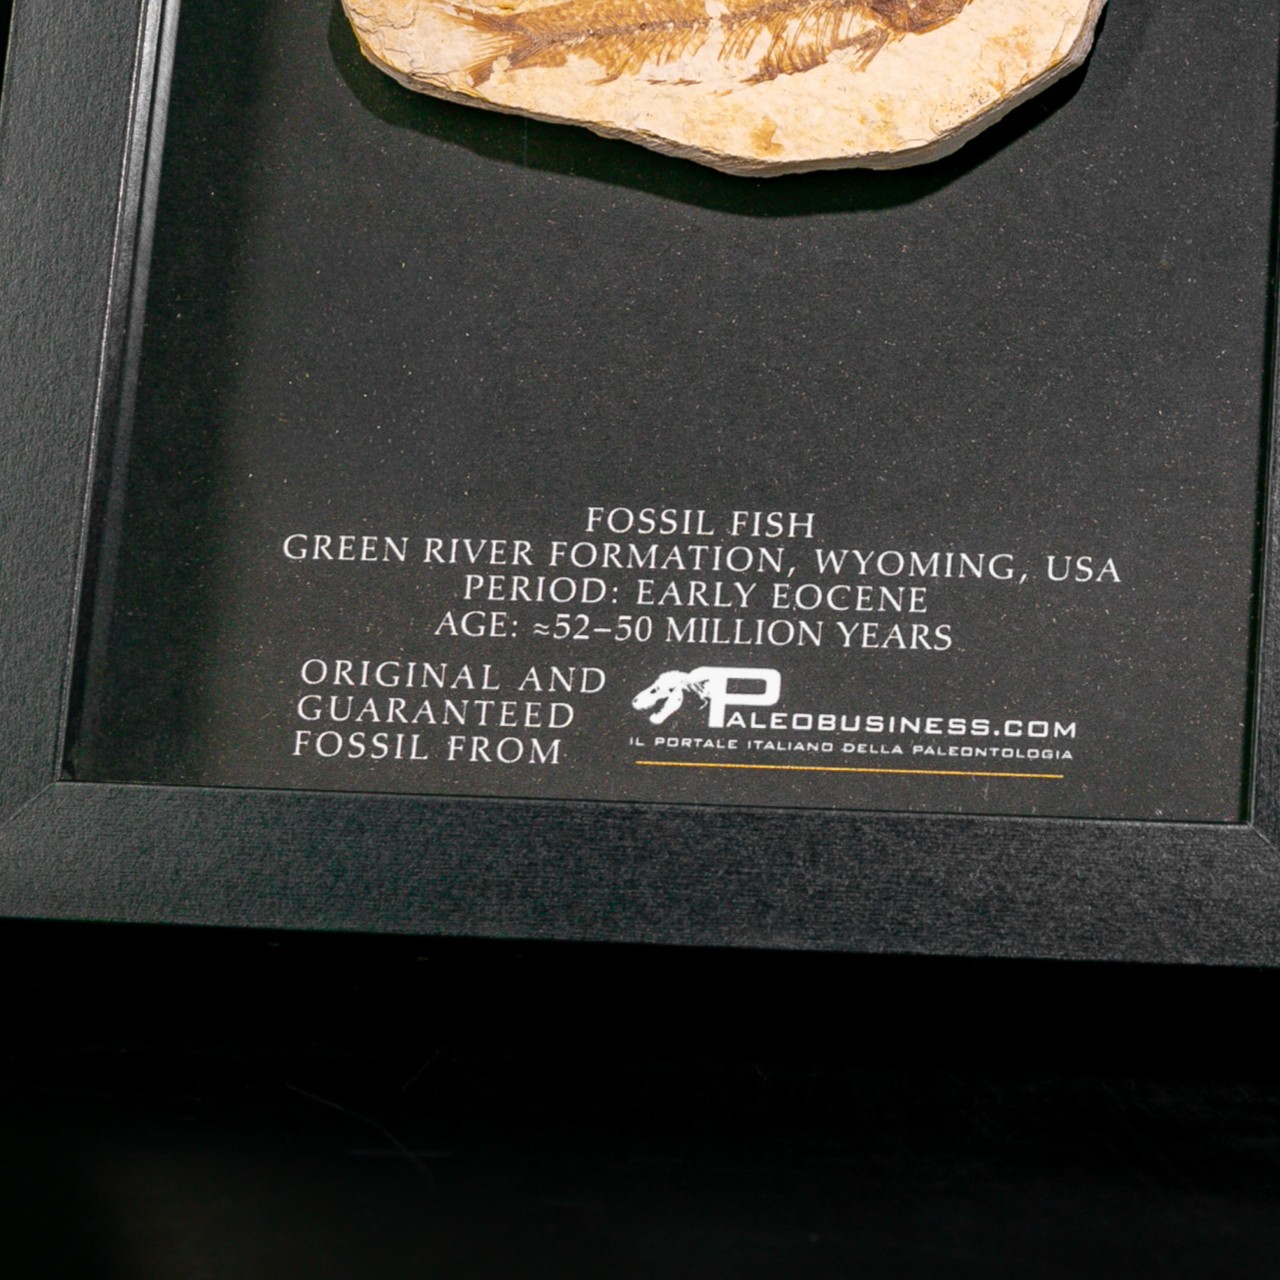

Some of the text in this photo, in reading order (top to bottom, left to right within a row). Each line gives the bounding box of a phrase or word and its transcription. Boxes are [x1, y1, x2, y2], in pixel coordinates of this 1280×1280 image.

[585, 506, 815, 539] FOSSIL FISH
[282, 533, 1122, 585] GREEN RIVER FORMATION, WYOMING, USA
[463, 574, 927, 614] PERIOD: EARLY EOCENE
[433, 610, 518, 638] AGE:
[665, 616, 824, 647] MILLION
[835, 621, 953, 651] YEARS
[300, 658, 606, 694] ORIGINAL AND
[297, 694, 575, 729] GUARANTEED
[292, 729, 562, 765] FOSSIL FROM
[629, 736, 1073, 761] IL PORTALE ITALIANO DELLA PALEONTOLOGIA
